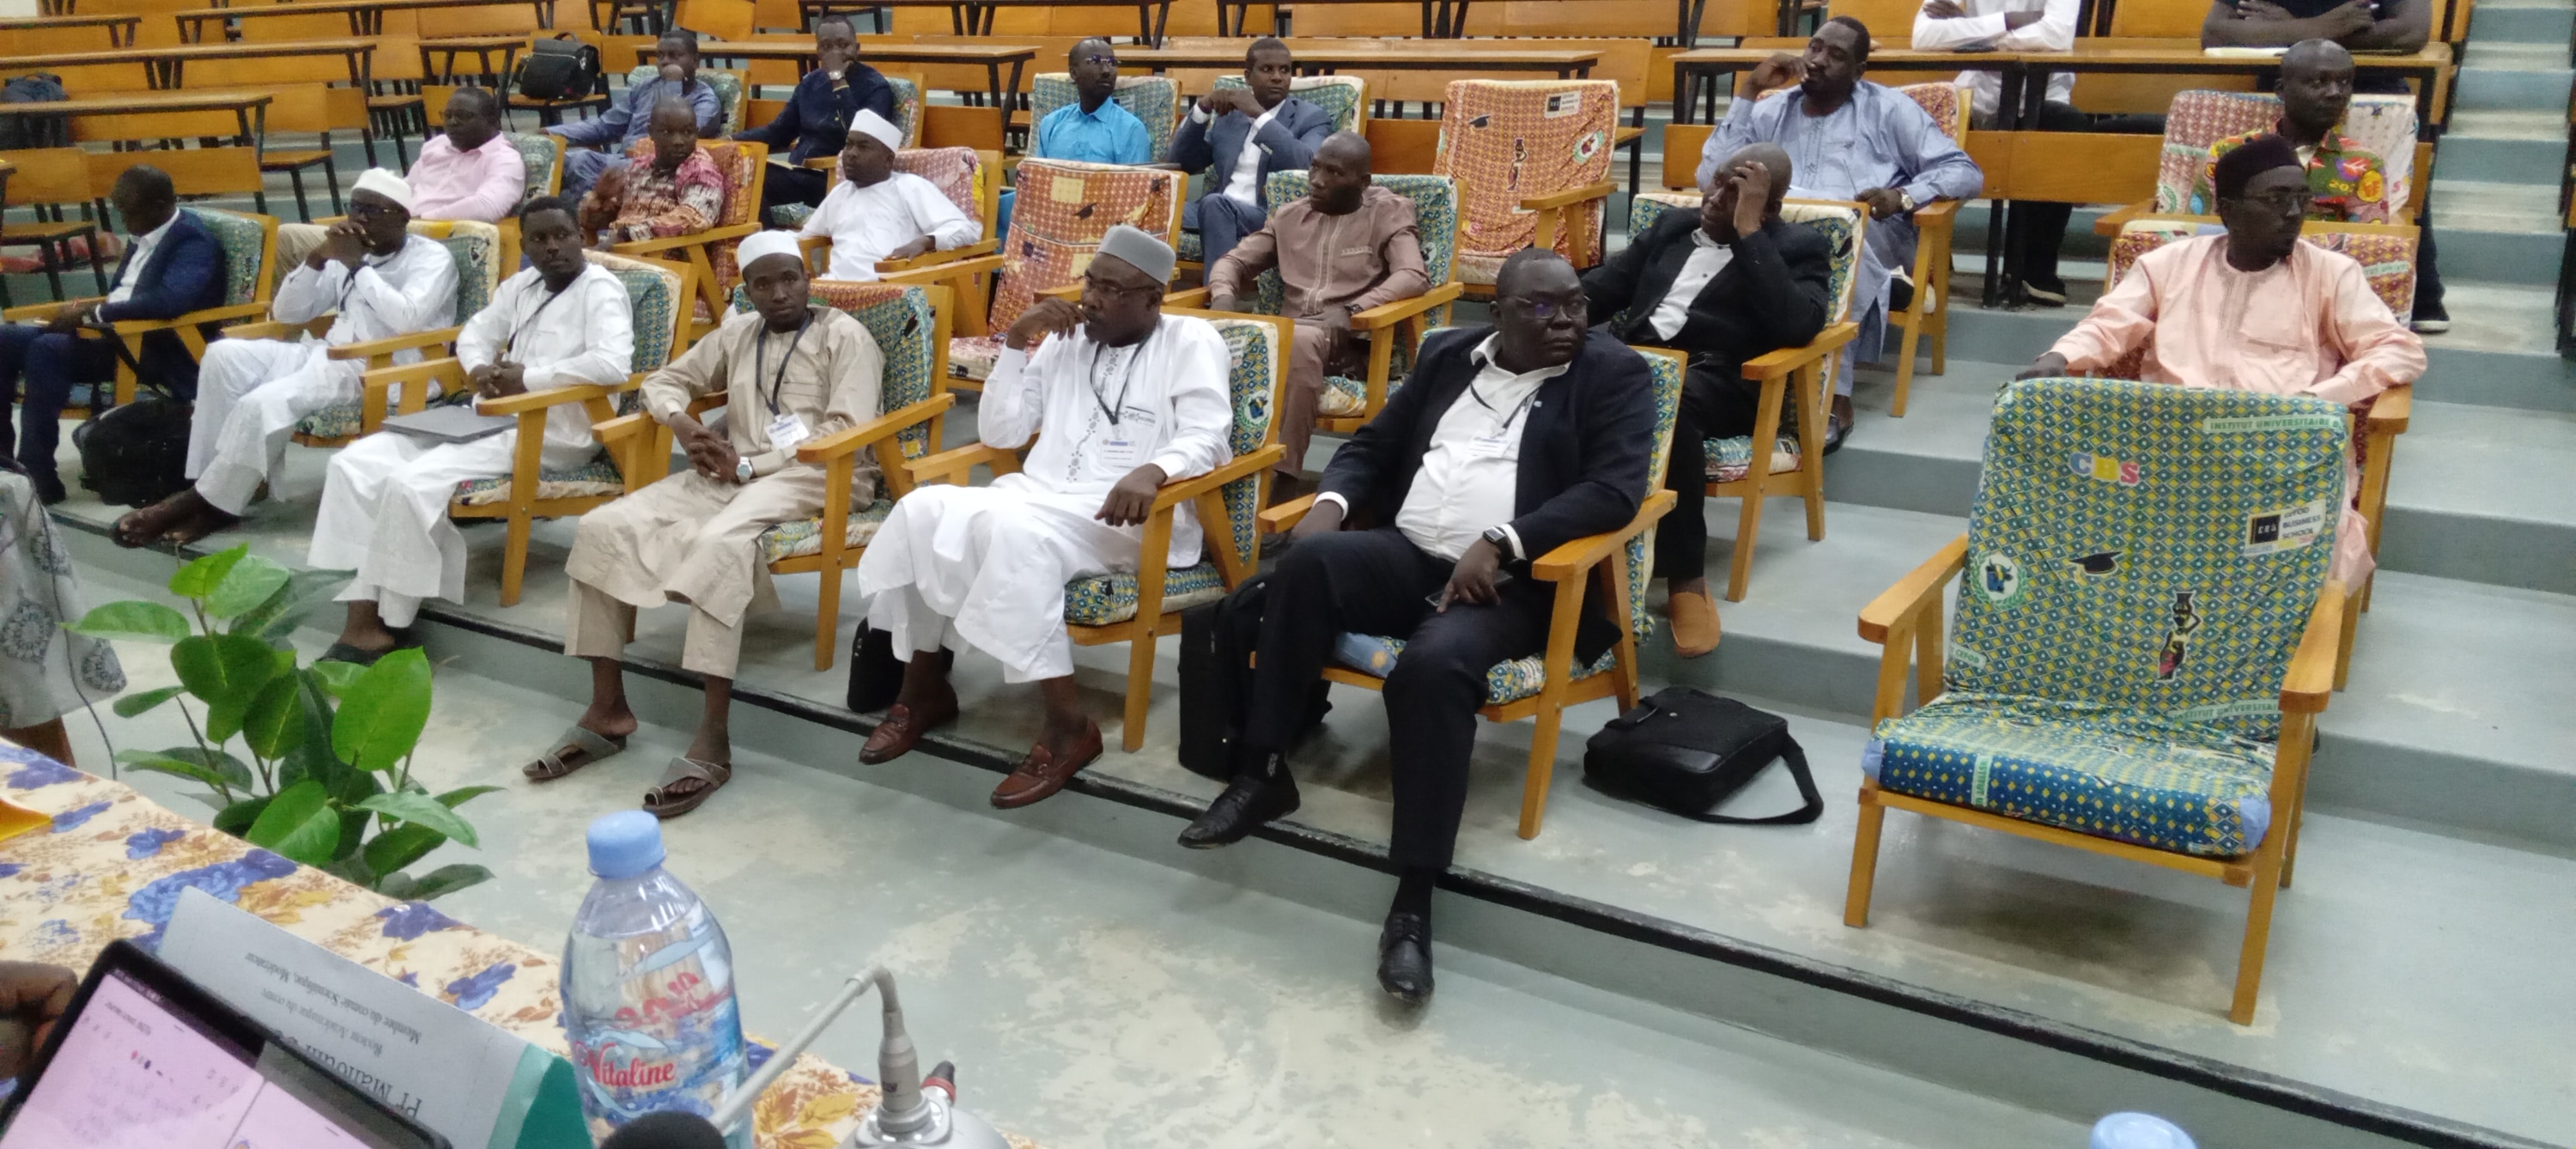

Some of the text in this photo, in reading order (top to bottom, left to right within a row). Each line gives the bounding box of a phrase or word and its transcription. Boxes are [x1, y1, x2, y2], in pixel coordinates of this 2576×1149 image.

[2210, 420, 2253, 430] INSTITUT
[2256, 416, 2330, 429] UNIVERSITAIRE
[2070, 452, 2139, 484] CBS
[2282, 514, 2322, 529] BUSINESS
[370, 1009, 383, 1025] du
[384, 1017, 422, 1044] Membre
[574, 1040, 675, 1088] Vitaline
